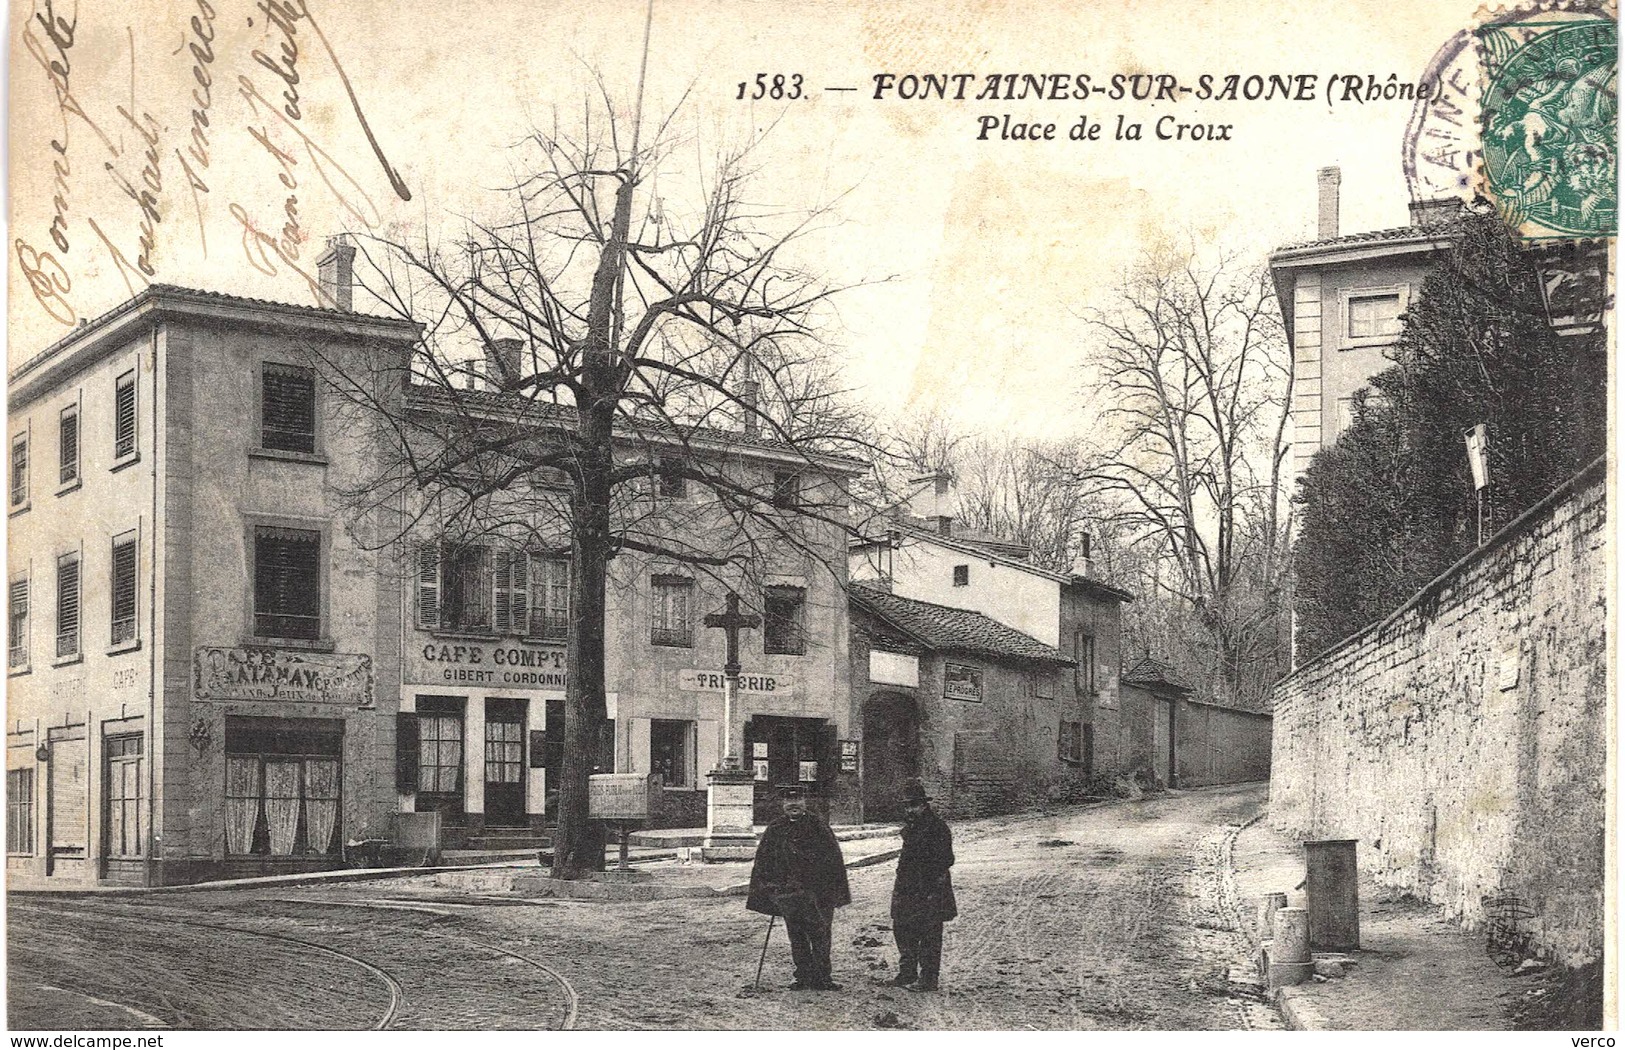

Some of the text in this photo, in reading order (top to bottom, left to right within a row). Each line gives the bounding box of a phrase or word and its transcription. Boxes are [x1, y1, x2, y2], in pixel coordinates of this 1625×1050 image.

[248, 126, 298, 190] et
[15, 139, 75, 327] Bonne
[492, 647, 566, 669] COMPT
[443, 669, 567, 686] GIBERT CORDONNI
[697, 673, 777, 692] TRIERIE
